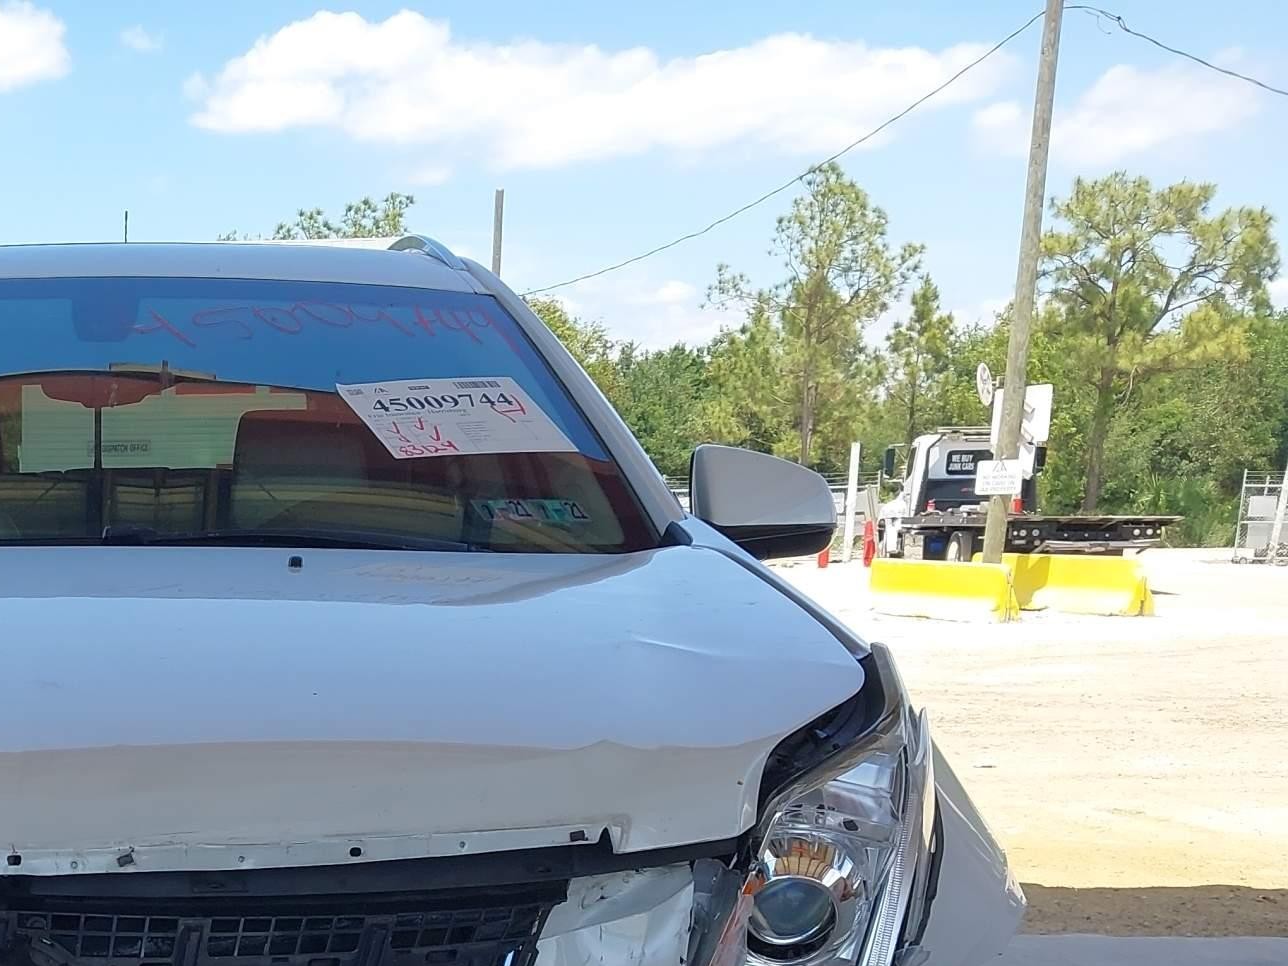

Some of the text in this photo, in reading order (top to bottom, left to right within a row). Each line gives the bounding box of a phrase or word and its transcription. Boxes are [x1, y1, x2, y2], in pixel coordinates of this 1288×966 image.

[373, 393, 514, 413] 45009744
[952, 454, 974, 462] WE BUY
[948, 462, 975, 471] JUNK CARS
